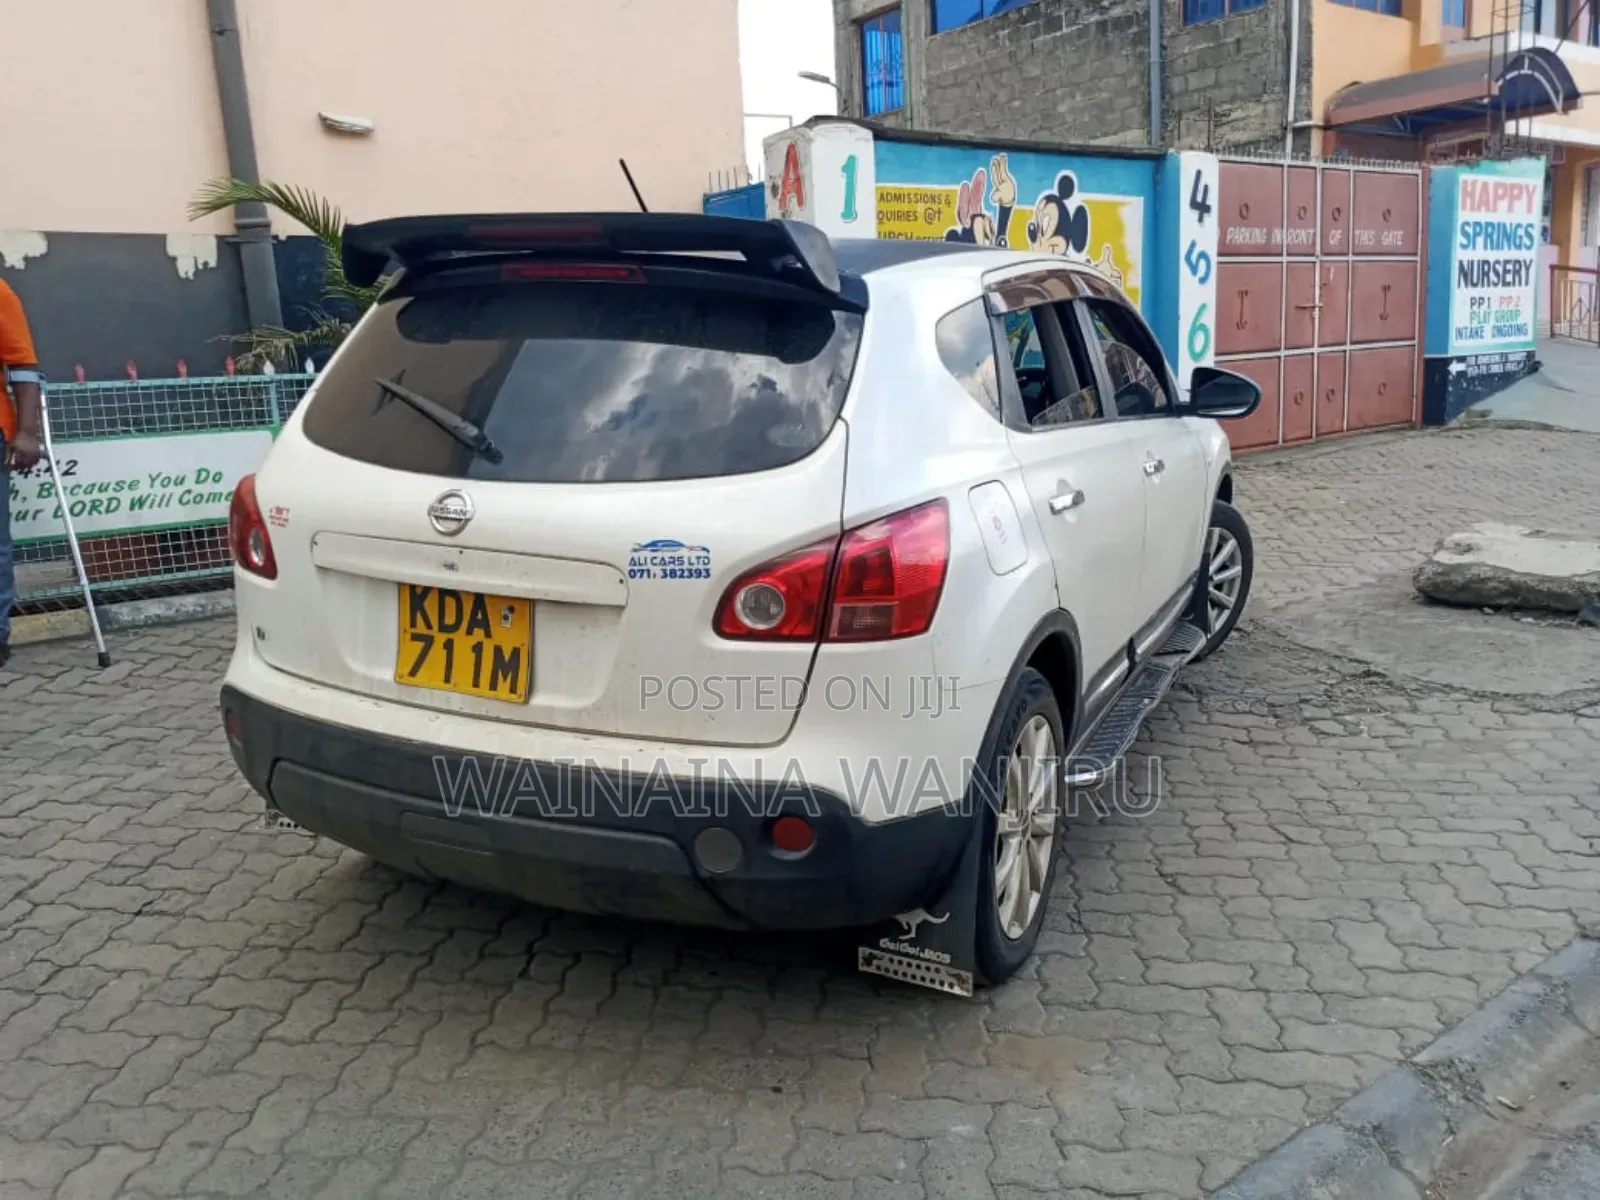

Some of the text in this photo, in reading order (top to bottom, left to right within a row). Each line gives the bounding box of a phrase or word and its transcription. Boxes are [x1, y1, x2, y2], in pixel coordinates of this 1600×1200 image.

[778, 141, 804, 212] A
[841, 154, 857, 222] 1
[879, 192, 942, 205] ADMISSIONS
[1189, 169, 1211, 223] 4
[1461, 179, 1537, 214] HAPPY
[1226, 227, 1267, 245] PARKING
[1329, 229, 1343, 246] OF
[1354, 230, 1375, 246] THIS
[1380, 231, 1403, 246] GATE
[1460, 221, 1534, 251] SPRINGS
[1185, 239, 1211, 285] 5
[1457, 259, 1532, 289] NURSERY
[1455, 322, 1529, 340] INTAKE ONGOING
[1470, 309, 1521, 324] PLAY GROUP
[1187, 303, 1211, 362] 6
[149, 471, 188, 489] You
[195, 468, 223, 484] Do
[53, 498, 121, 519] LORD
[129, 494, 171, 511] Will
[628, 556, 711, 567] ALI CARS LTD
[661, 569, 711, 579] 382393
[409, 584, 493, 639] KDA
[408, 632, 521, 694] 711M
